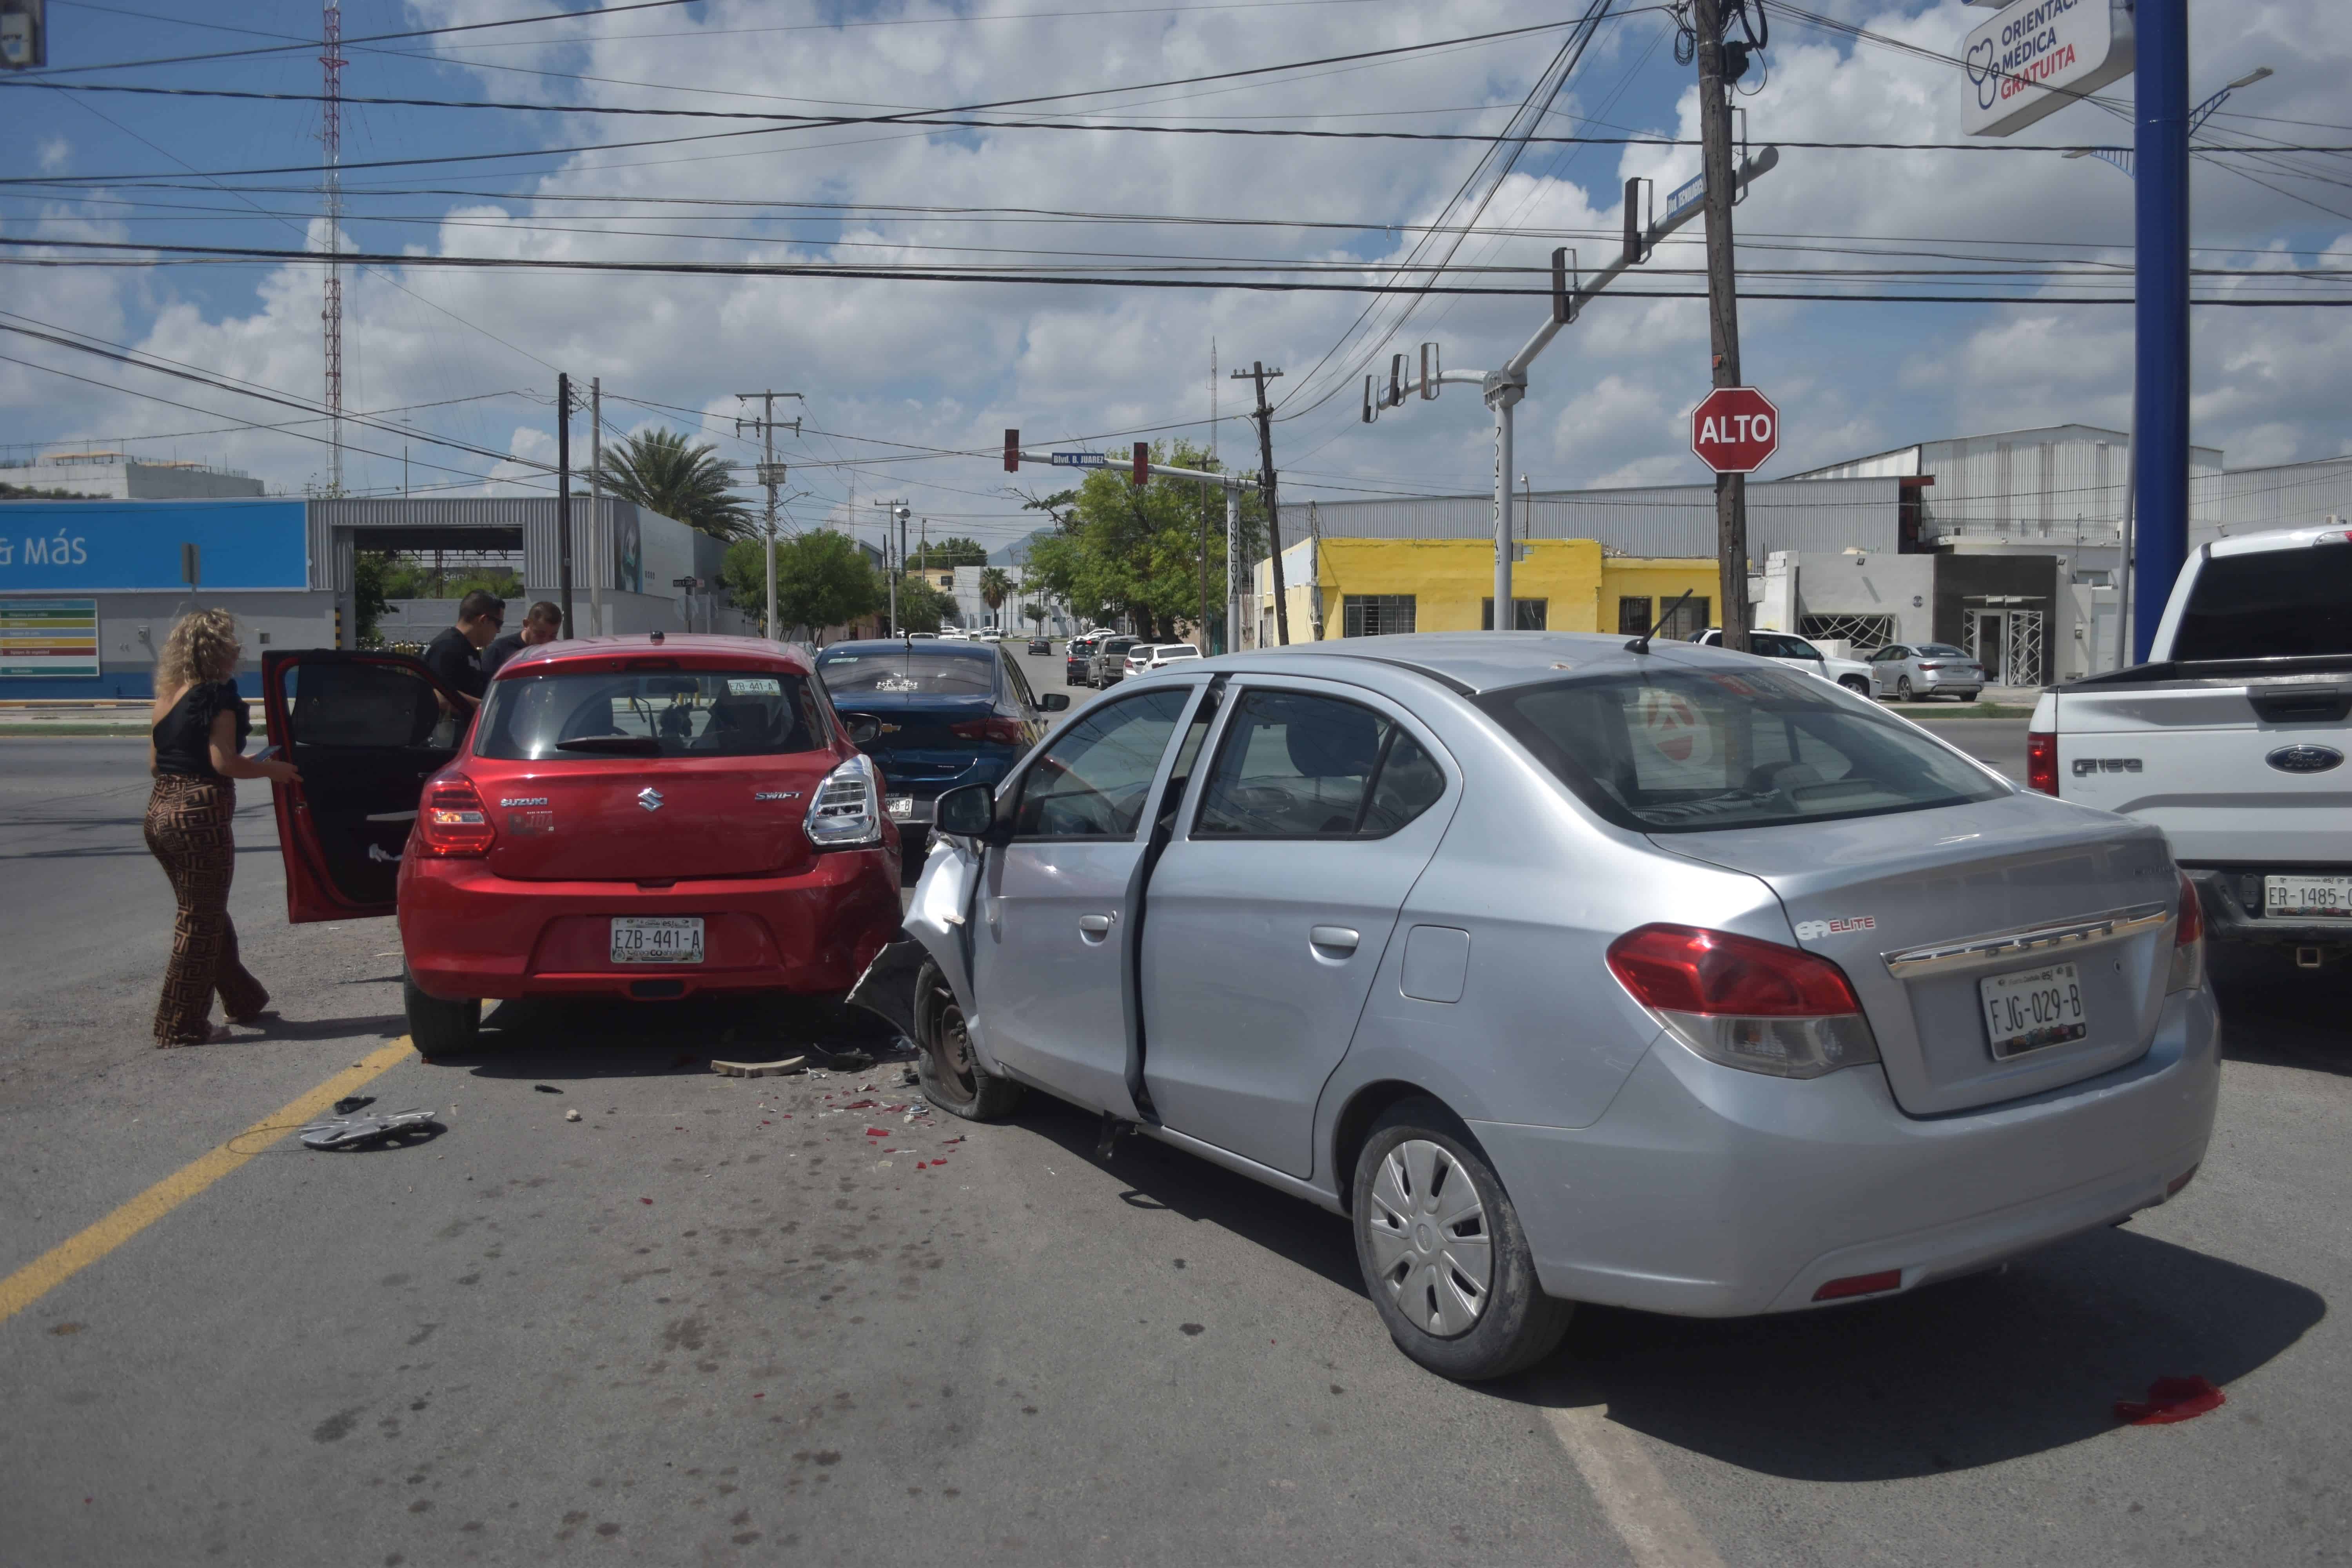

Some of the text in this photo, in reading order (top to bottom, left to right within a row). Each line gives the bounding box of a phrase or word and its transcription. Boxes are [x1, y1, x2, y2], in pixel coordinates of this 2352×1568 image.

[2002, 26, 2056, 74] MÉDICA
[2001, 43, 2076, 100] GRATUITA
[1699, 414, 1771, 444] ALTO
[1053, 455, 1104, 464] Blvd. B. JUAREZ
[730, 682, 773, 690] EZB-441-A
[2285, 751, 2326, 767] Ford
[501, 797, 548, 807] SUZUKI
[755, 791, 803, 800] SWIFT
[1829, 916, 1875, 933] ELITE
[615, 929, 700, 949] EZB-441-A
[1989, 984, 2081, 1035] FJG-029-B
